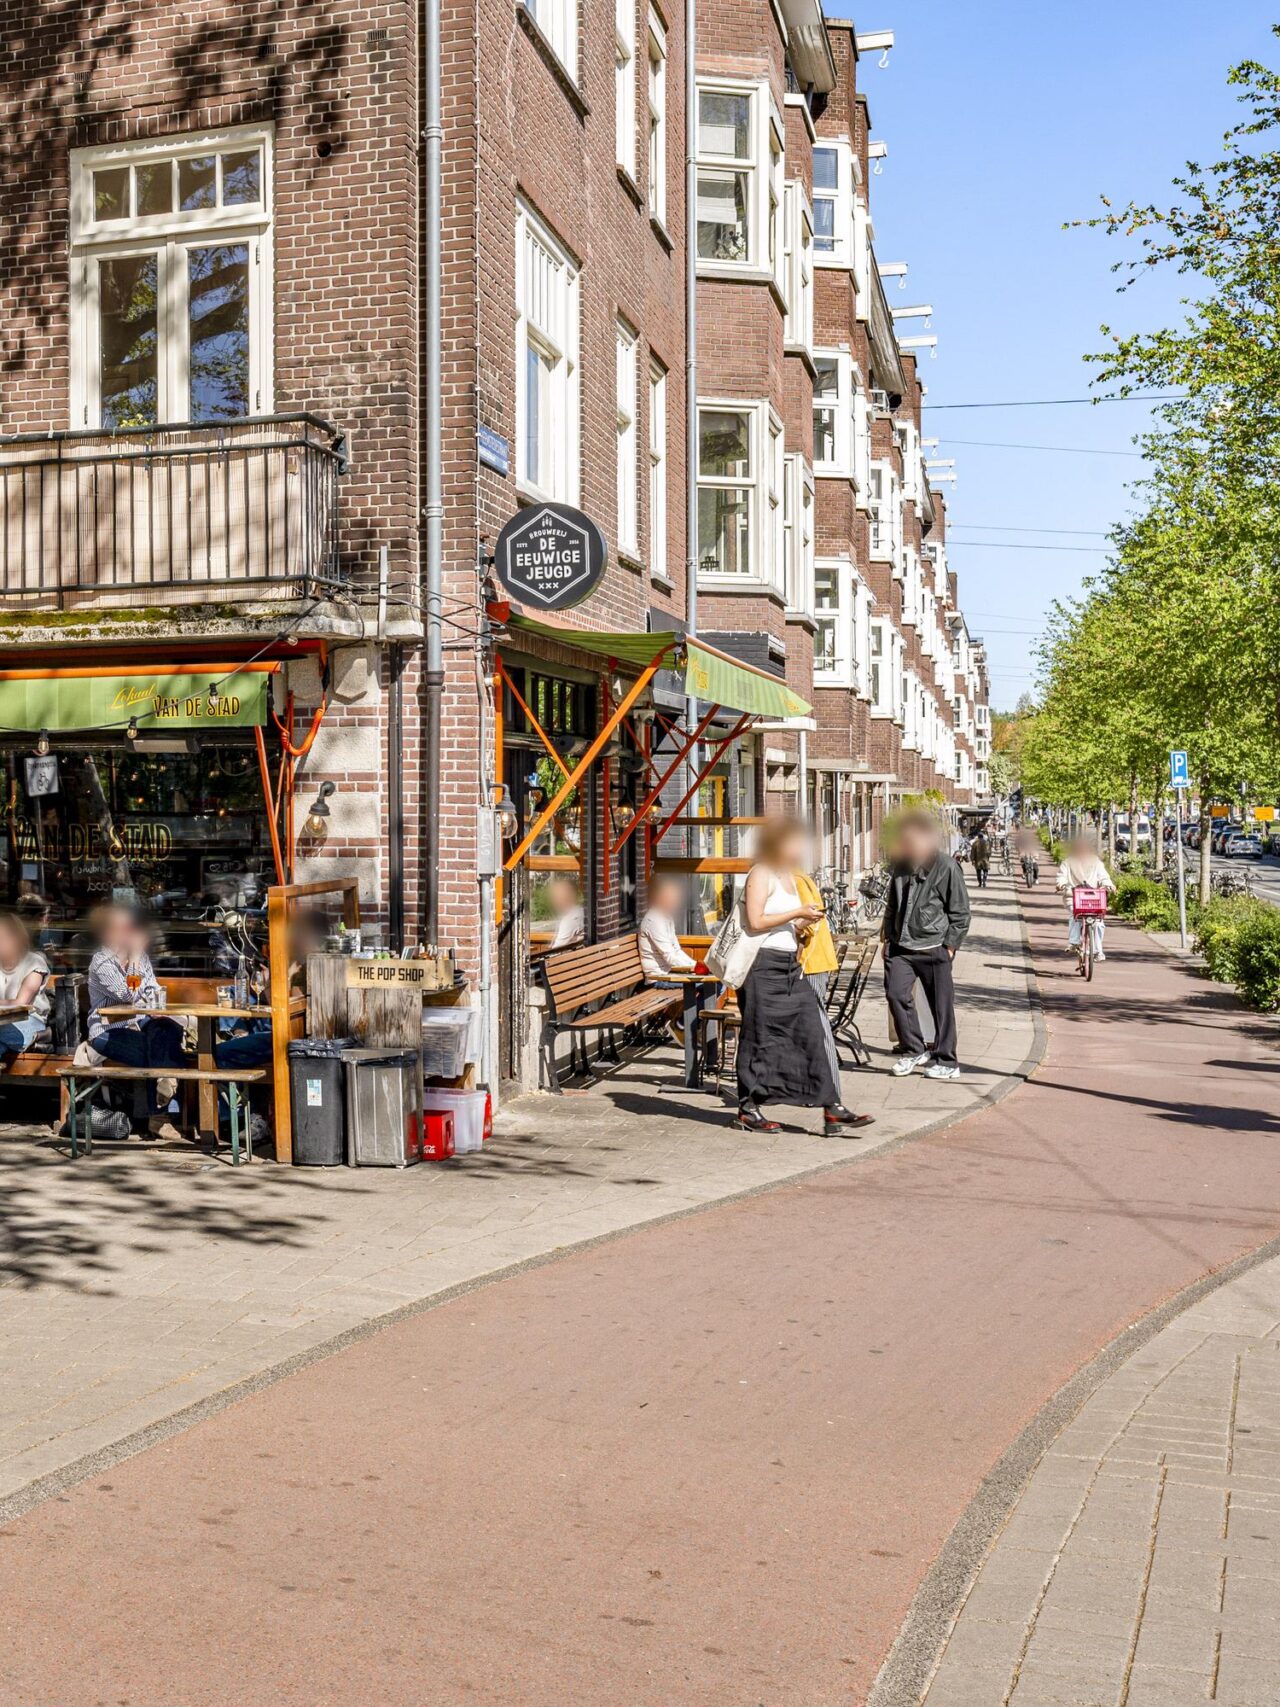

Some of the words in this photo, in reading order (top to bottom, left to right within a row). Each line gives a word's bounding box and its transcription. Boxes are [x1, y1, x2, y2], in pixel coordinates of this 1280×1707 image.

[528, 529, 567, 539] BROUWERIJ
[540, 537, 556, 550] DE
[516, 550, 580, 566] EEUWIGE
[526, 565, 572, 580] JEUGD
[110, 683, 156, 709] Lokaal
[153, 694, 180, 718] VAN
[184, 697, 203, 717] DE
[206, 696, 241, 717] STAD
[1175, 755, 1184, 773] P
[16, 815, 60, 861] VAN
[69, 823, 100, 861] DE
[109, 823, 171, 862] STAD
[358, 966, 374, 980] THE
[377, 967, 395, 980] POP
[398, 968, 424, 981] SHOP
